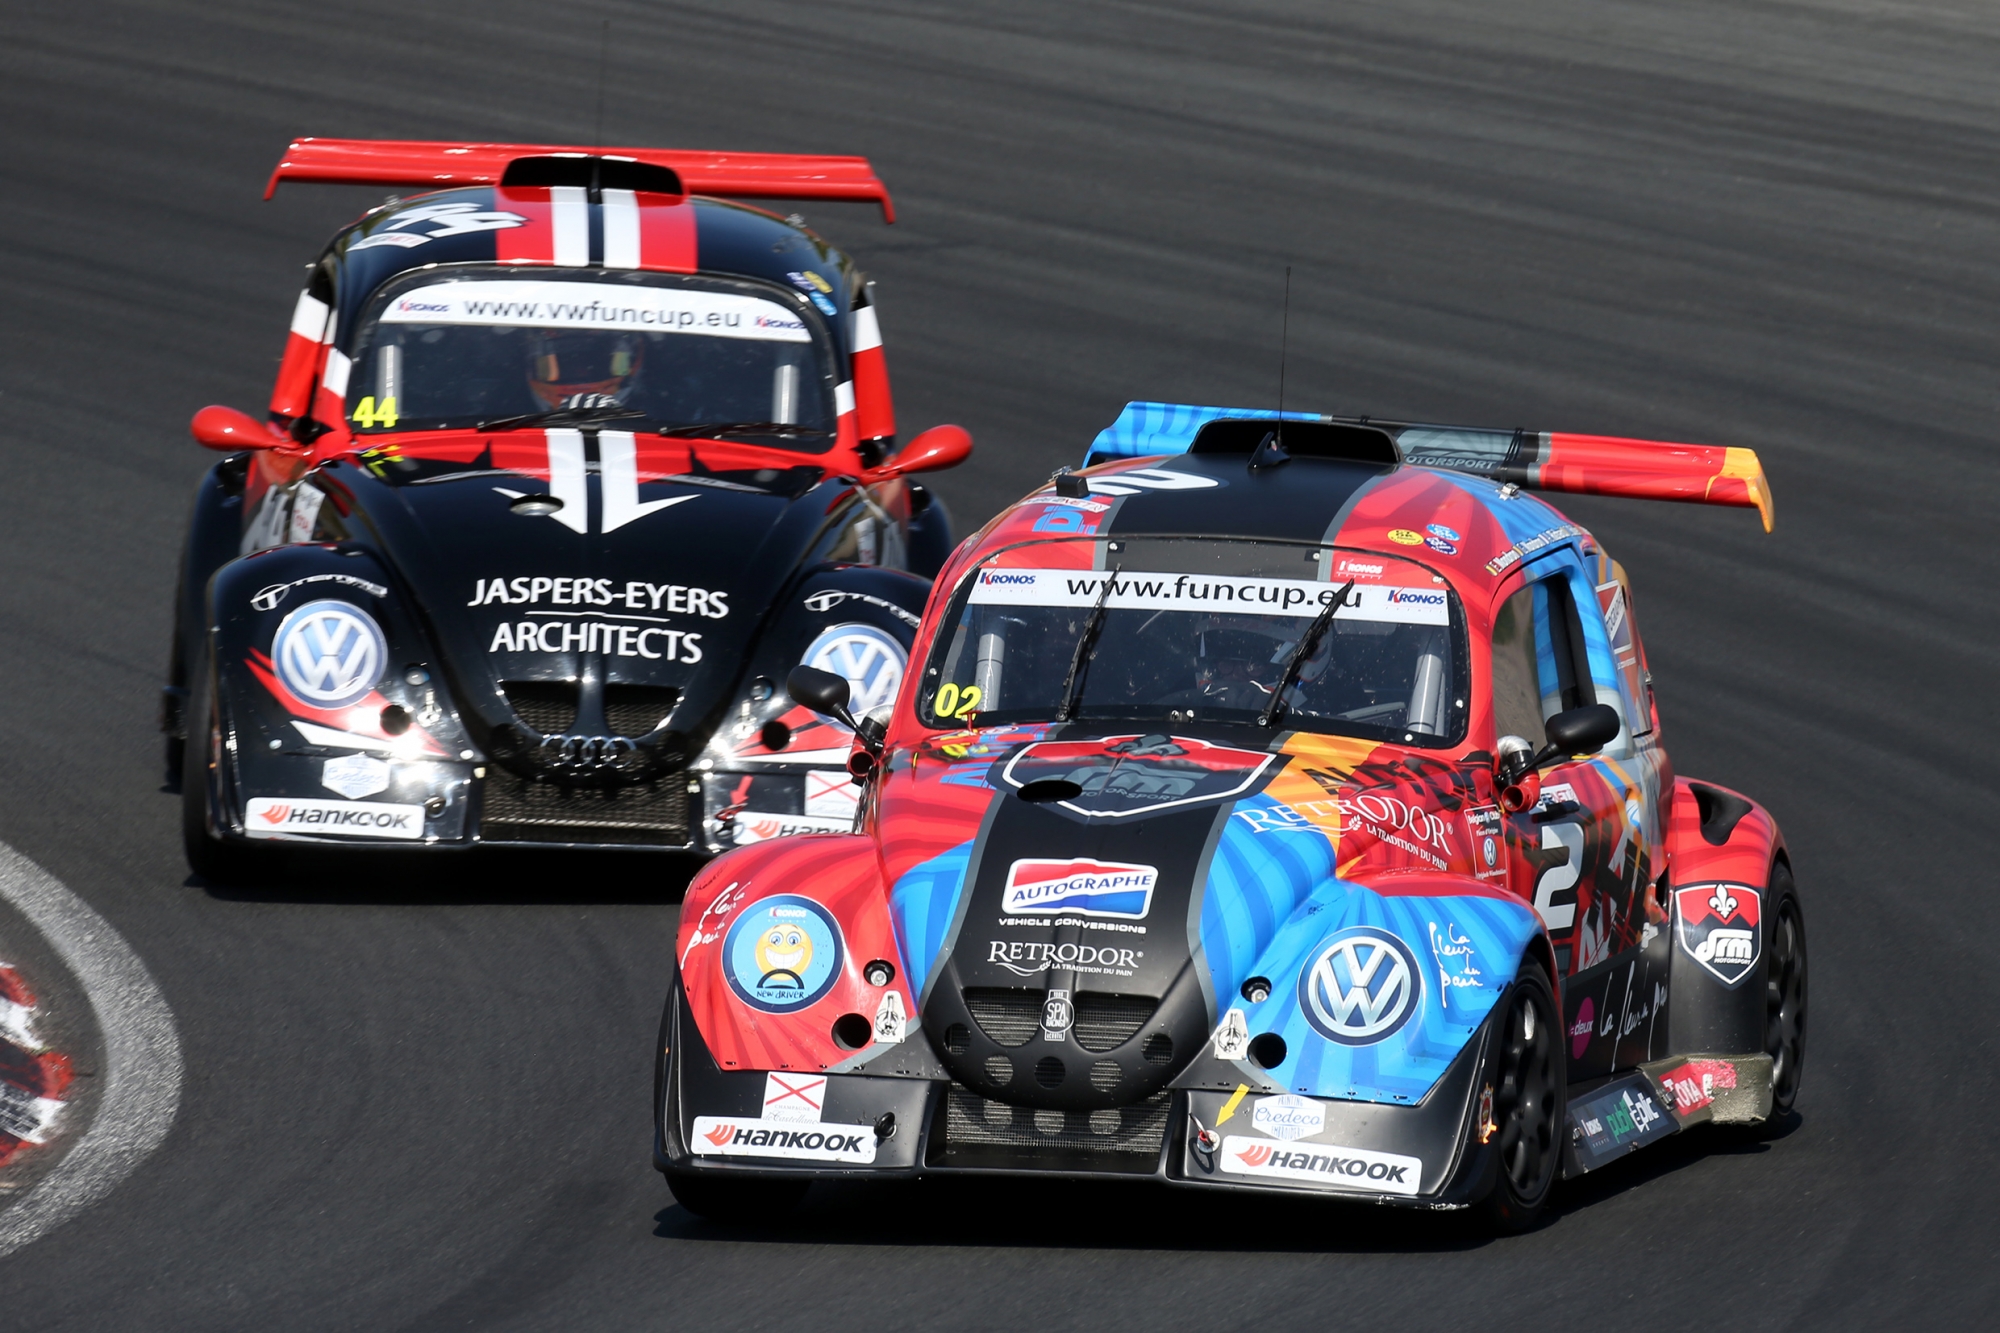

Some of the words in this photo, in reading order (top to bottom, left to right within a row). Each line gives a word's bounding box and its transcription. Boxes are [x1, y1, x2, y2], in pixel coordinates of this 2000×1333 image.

[464, 300, 741, 328] www.vwfuncup.eu
[353, 396, 399, 428] 44
[1403, 455, 1497, 470] OTORSPORT
[1339, 560, 1383, 574] KRONOS
[980, 570, 1036, 586] KRONOS
[467, 577, 729, 619] JASPERS-EYERS
[1066, 574, 1362, 609] www.funcup.eu
[1387, 589, 1445, 605] KRONOS
[489, 622, 703, 664] ARCHITECTS
[935, 682, 982, 722] 02
[1366, 823, 1378, 836] LA
[1377, 828, 1419, 856] TRADITION
[1420, 846, 1431, 862] DU
[1432, 854, 1448, 871] PAIN
[1533, 822, 1584, 931] 2
[1011, 874, 1153, 903] AUTOGRAPHE
[768, 907, 807, 918] KRONOS
[998, 917, 1052, 927] VEHICLE
[1054, 917, 1147, 934] CONVERSIONS
[1062, 963, 1101, 974] TRADITION
[1103, 967, 1115, 976] DU
[1116, 969, 1134, 977] PAIN
[1713, 957, 1752, 966] MOTORSPORT
[1046, 1002, 1067, 1020] SPA
[774, 1103, 811, 1113] CHAMPAGNE
[1255, 1106, 1323, 1126] Credeco
